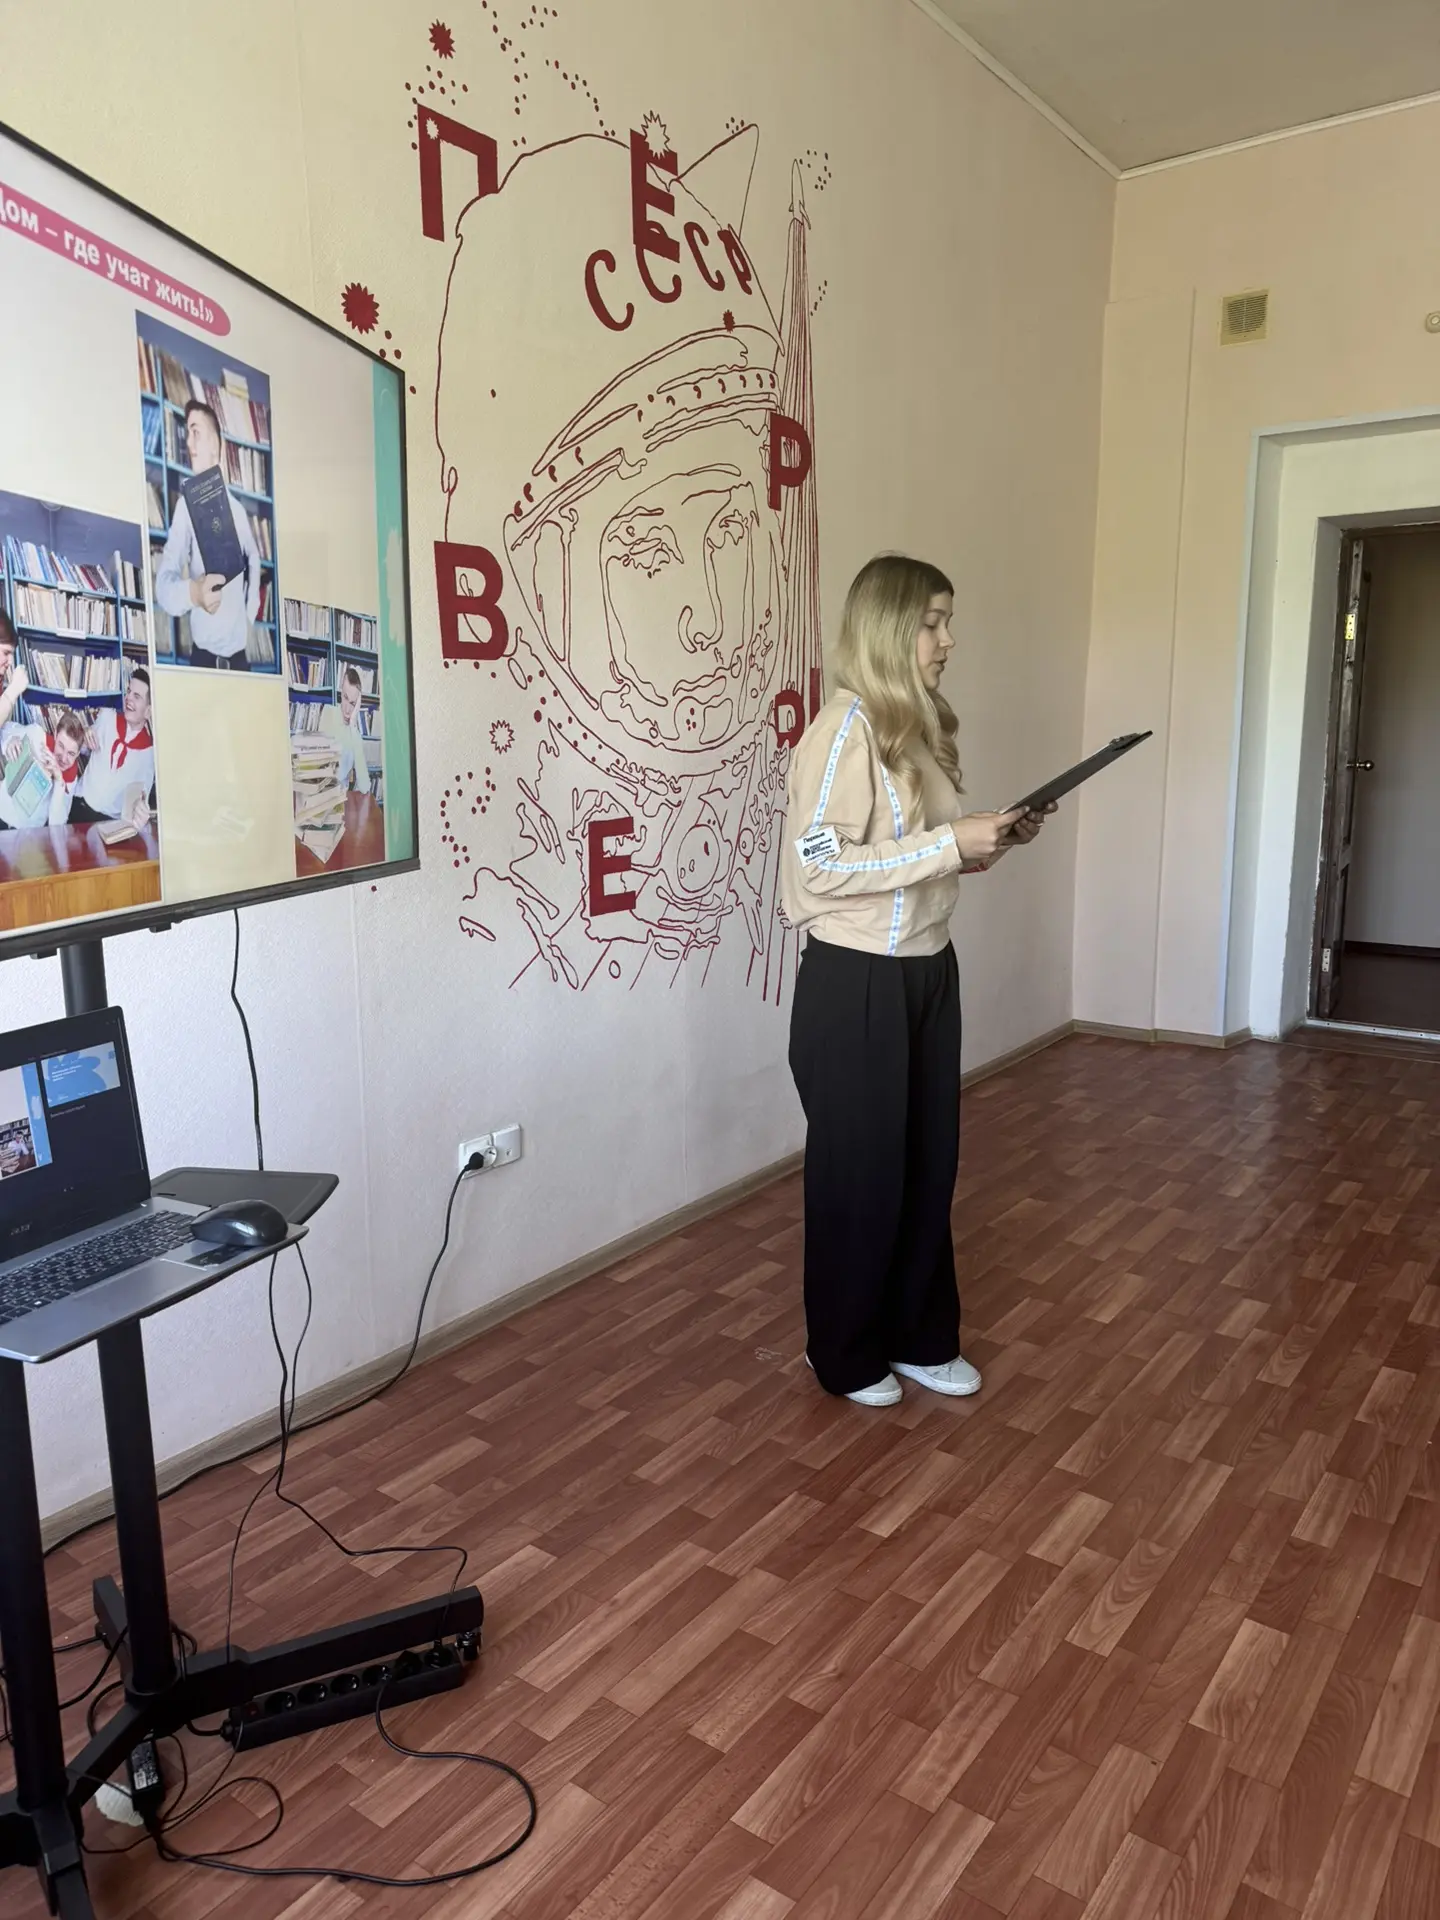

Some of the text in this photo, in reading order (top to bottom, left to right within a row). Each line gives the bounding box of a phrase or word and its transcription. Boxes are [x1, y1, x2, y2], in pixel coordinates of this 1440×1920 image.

[64, 230, 100, 265] где
[105, 252, 151, 291] учат
[155, 278, 214, 324] жить!»
[585, 221, 752, 332] СССР
